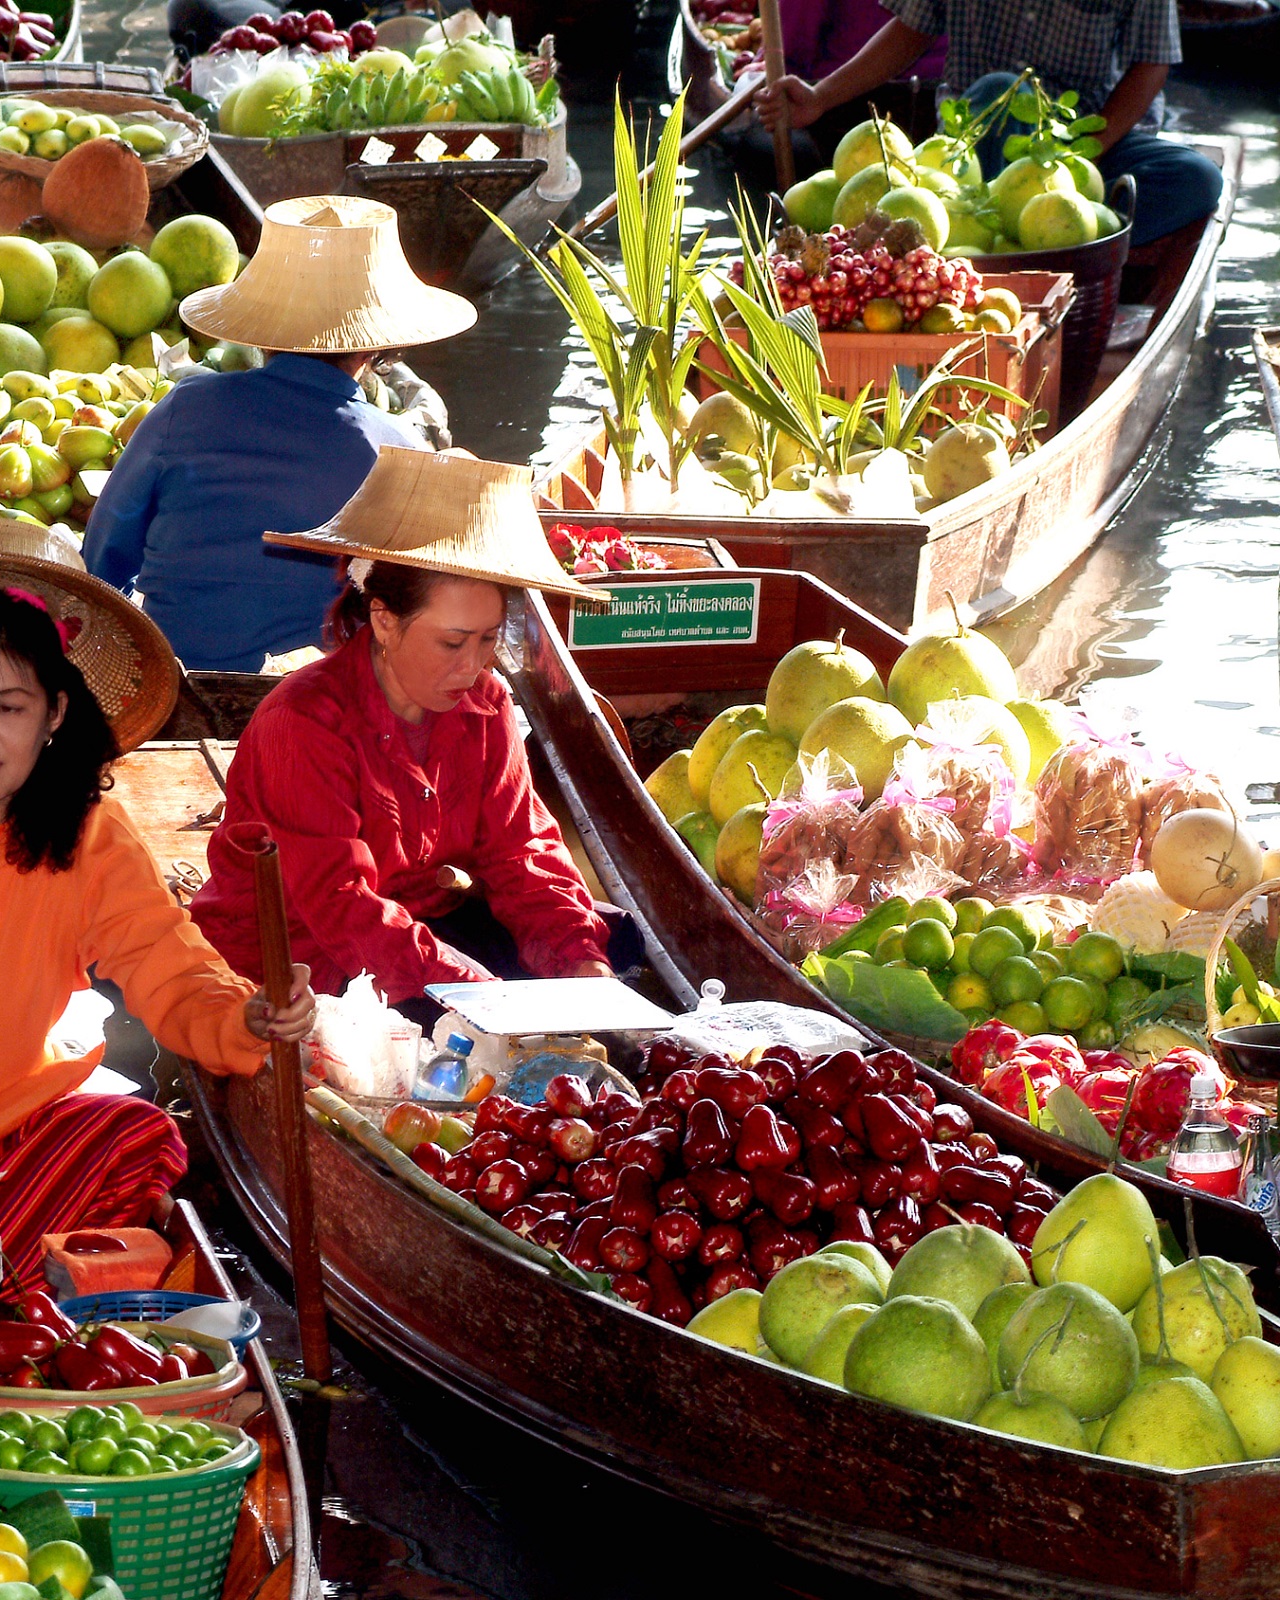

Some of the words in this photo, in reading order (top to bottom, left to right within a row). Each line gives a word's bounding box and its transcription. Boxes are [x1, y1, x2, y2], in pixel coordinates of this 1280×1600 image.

[665, 587, 754, 613] ไม่ทิ้งขยะลงคลอง
[621, 626, 666, 639] สนับสนุนโดย
[715, 626, 730, 635] และ
